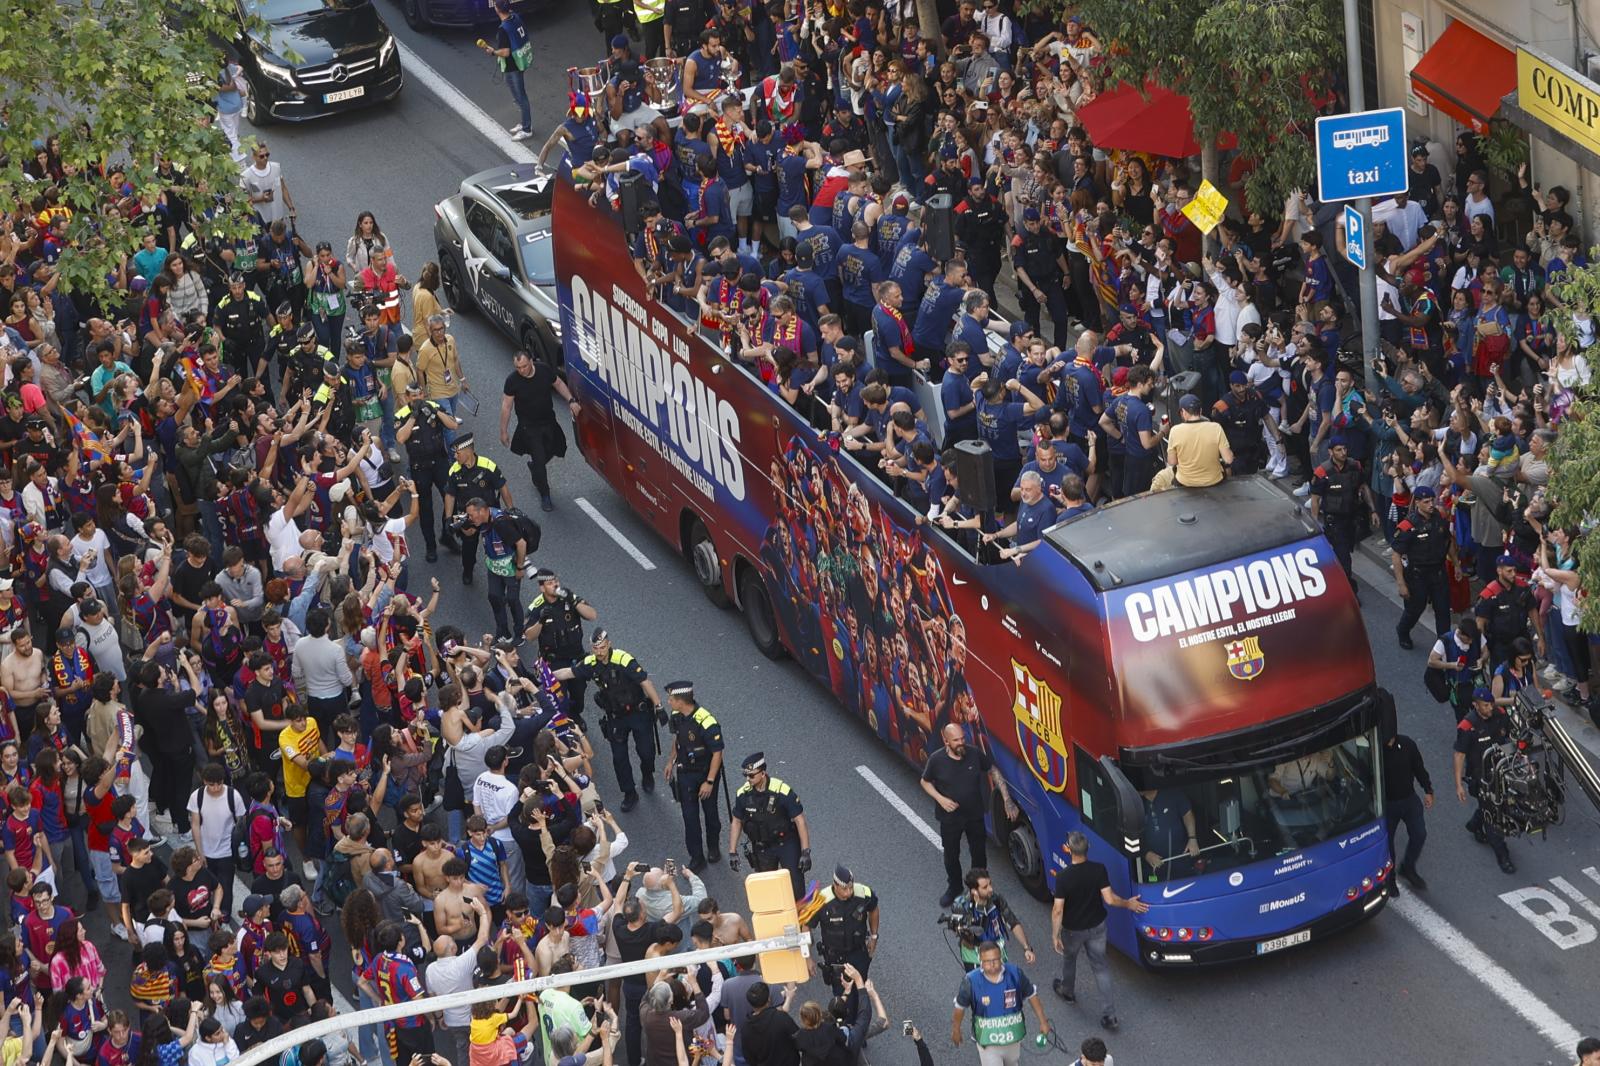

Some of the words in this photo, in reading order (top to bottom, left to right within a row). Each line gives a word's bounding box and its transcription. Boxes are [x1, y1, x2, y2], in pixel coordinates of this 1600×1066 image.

[1532, 67, 1600, 129] COMP
[1347, 165, 1380, 185] taxi
[1350, 215, 1359, 236] P
[480, 287, 501, 318] SAFETY
[501, 306, 516, 332] CAR
[612, 283, 648, 329] SUPERCOPA
[651, 316, 669, 347] COPA
[672, 333, 690, 364] LLIGA
[571, 274, 745, 501] CAMPIONS
[613, 398, 622, 420] EL
[620, 404, 645, 440] NOSTRE
[661, 440, 671, 462] EL
[669, 447, 694, 484] NOSTRE
[692, 468, 715, 503] LLEGAT
[1124, 547, 1327, 643] CAMPIONS
[1178, 636, 1190, 649] EL
[1189, 628, 1217, 647] NOSTRE
[1216, 626, 1238, 640] ESTIL,
[1237, 622, 1247, 634] EL
[1246, 614, 1274, 631] NOSTRE
[1272, 608, 1297, 626] LLEGAT
[1028, 715, 1051, 744] FCB
[1350, 825, 1380, 844] CUPRA
[1273, 860, 1307, 877] AMBILIGHT
[1282, 854, 1304, 865] PHILIPS
[1263, 938, 1288, 952] 2396
[978, 1014, 1023, 1029] OPERACIONS
